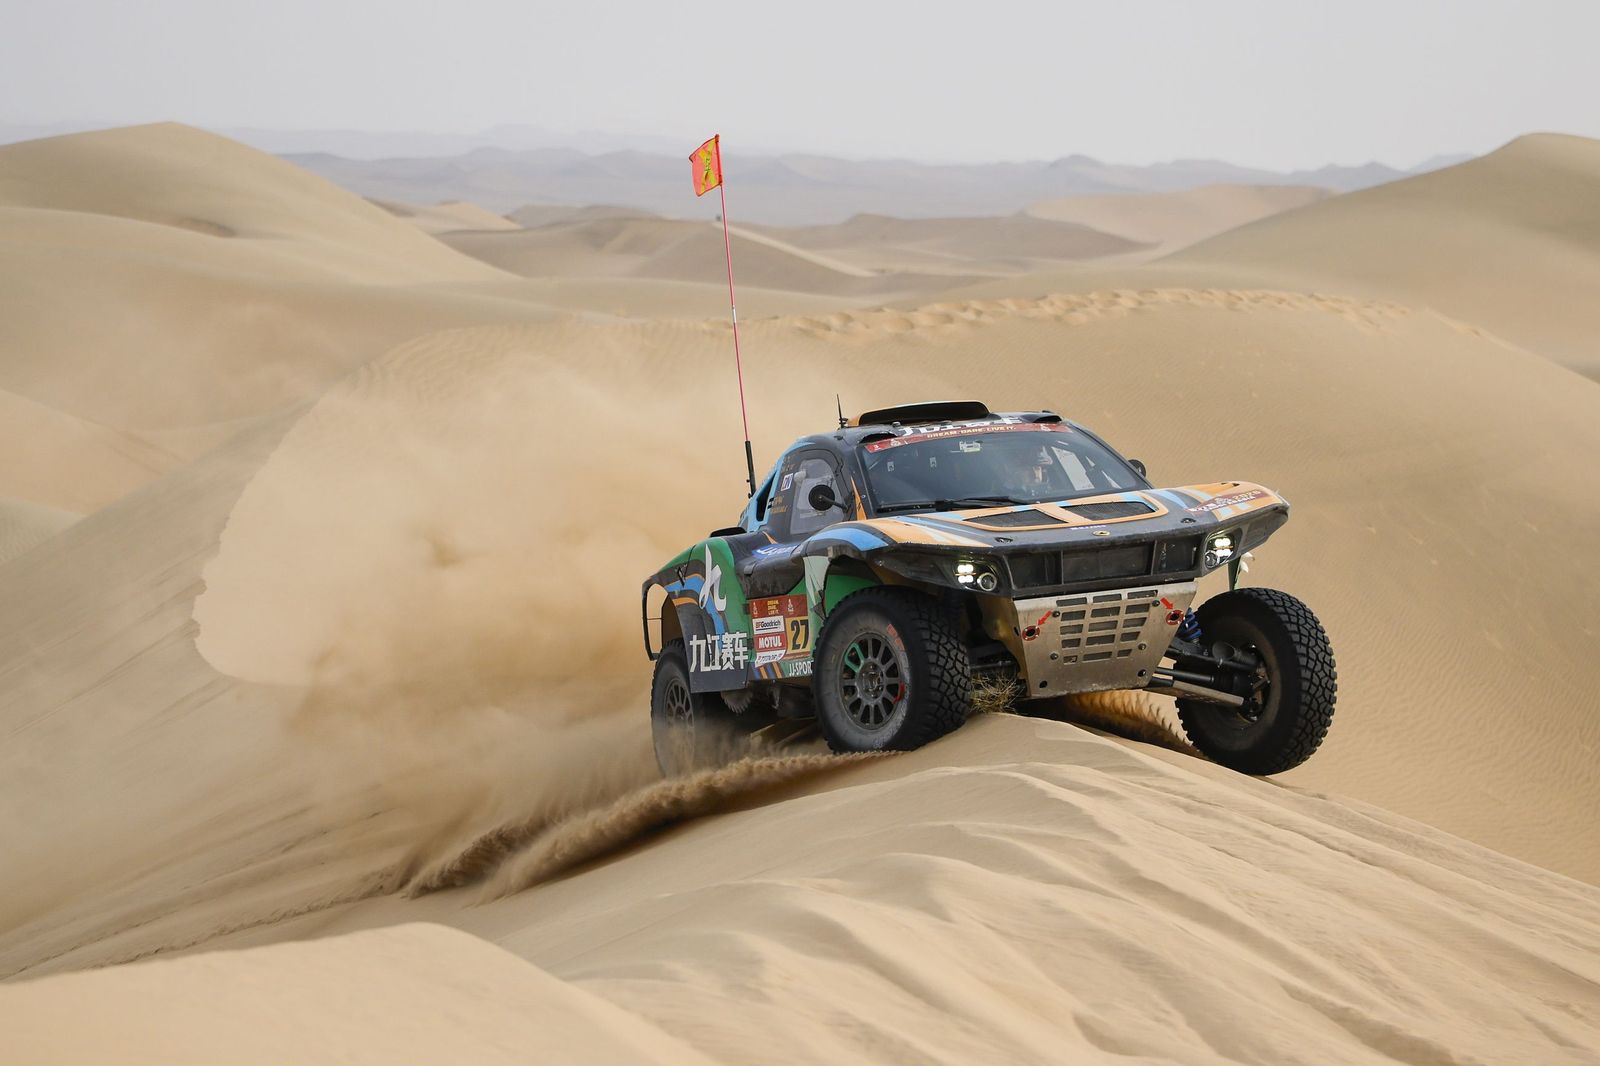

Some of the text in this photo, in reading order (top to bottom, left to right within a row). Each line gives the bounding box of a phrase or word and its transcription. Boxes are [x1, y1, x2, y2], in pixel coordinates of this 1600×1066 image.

[756, 619, 781, 628] BFGoodrich
[791, 619, 809, 650] 27
[689, 632, 748, 673] 九江赛车
[759, 636, 783, 649] MOTUL
